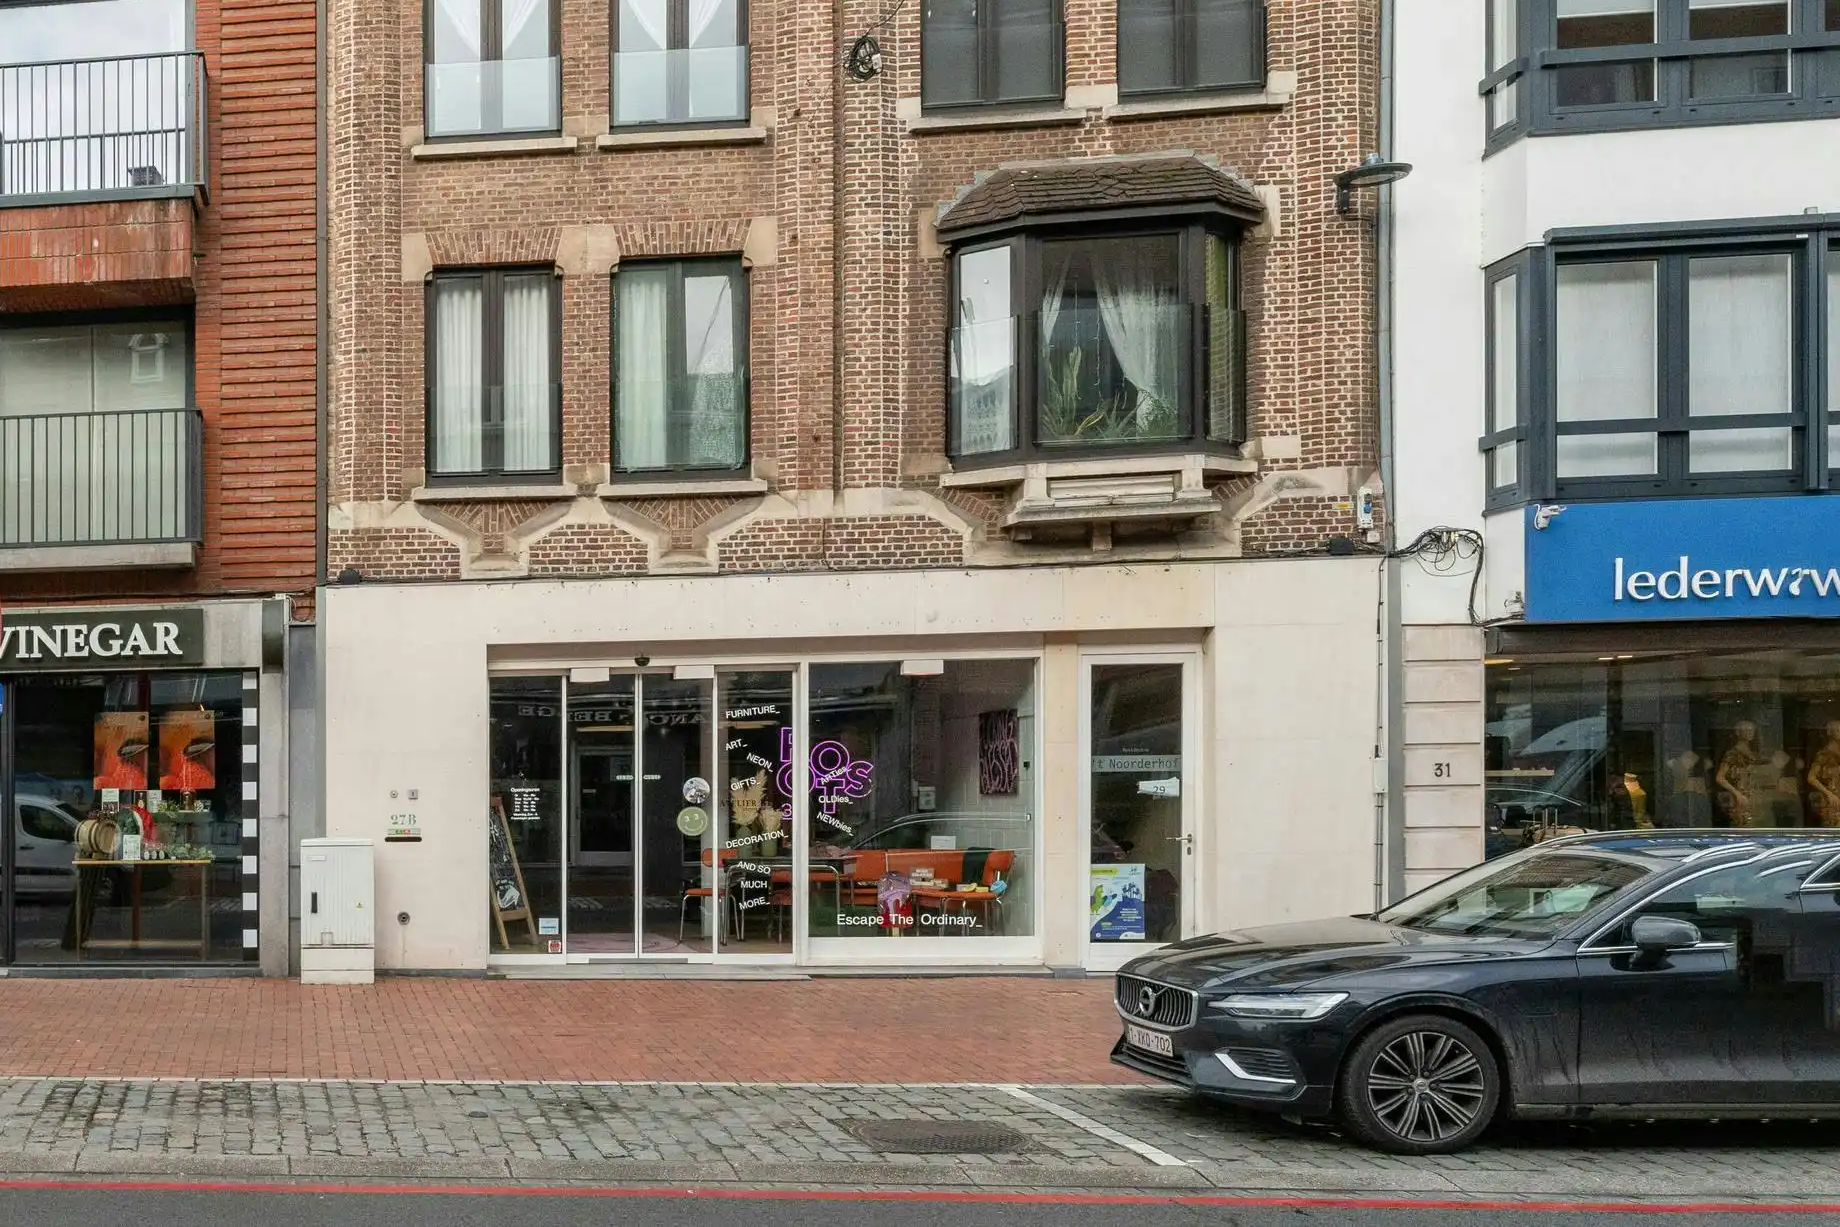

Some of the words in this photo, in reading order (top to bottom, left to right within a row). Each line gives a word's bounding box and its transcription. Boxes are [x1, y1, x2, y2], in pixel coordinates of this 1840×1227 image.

[1109, 758, 1178, 769] Noorderhof
[1434, 762, 1451, 778] 31
[1152, 785, 1166, 794] 29
[390, 814, 417, 825] 27B
[736, 861, 756, 872] AND
[757, 865, 771, 875] SO
[740, 880, 768, 889] MUCH
[836, 914, 884, 927] Escape
[890, 913, 914, 925] The
